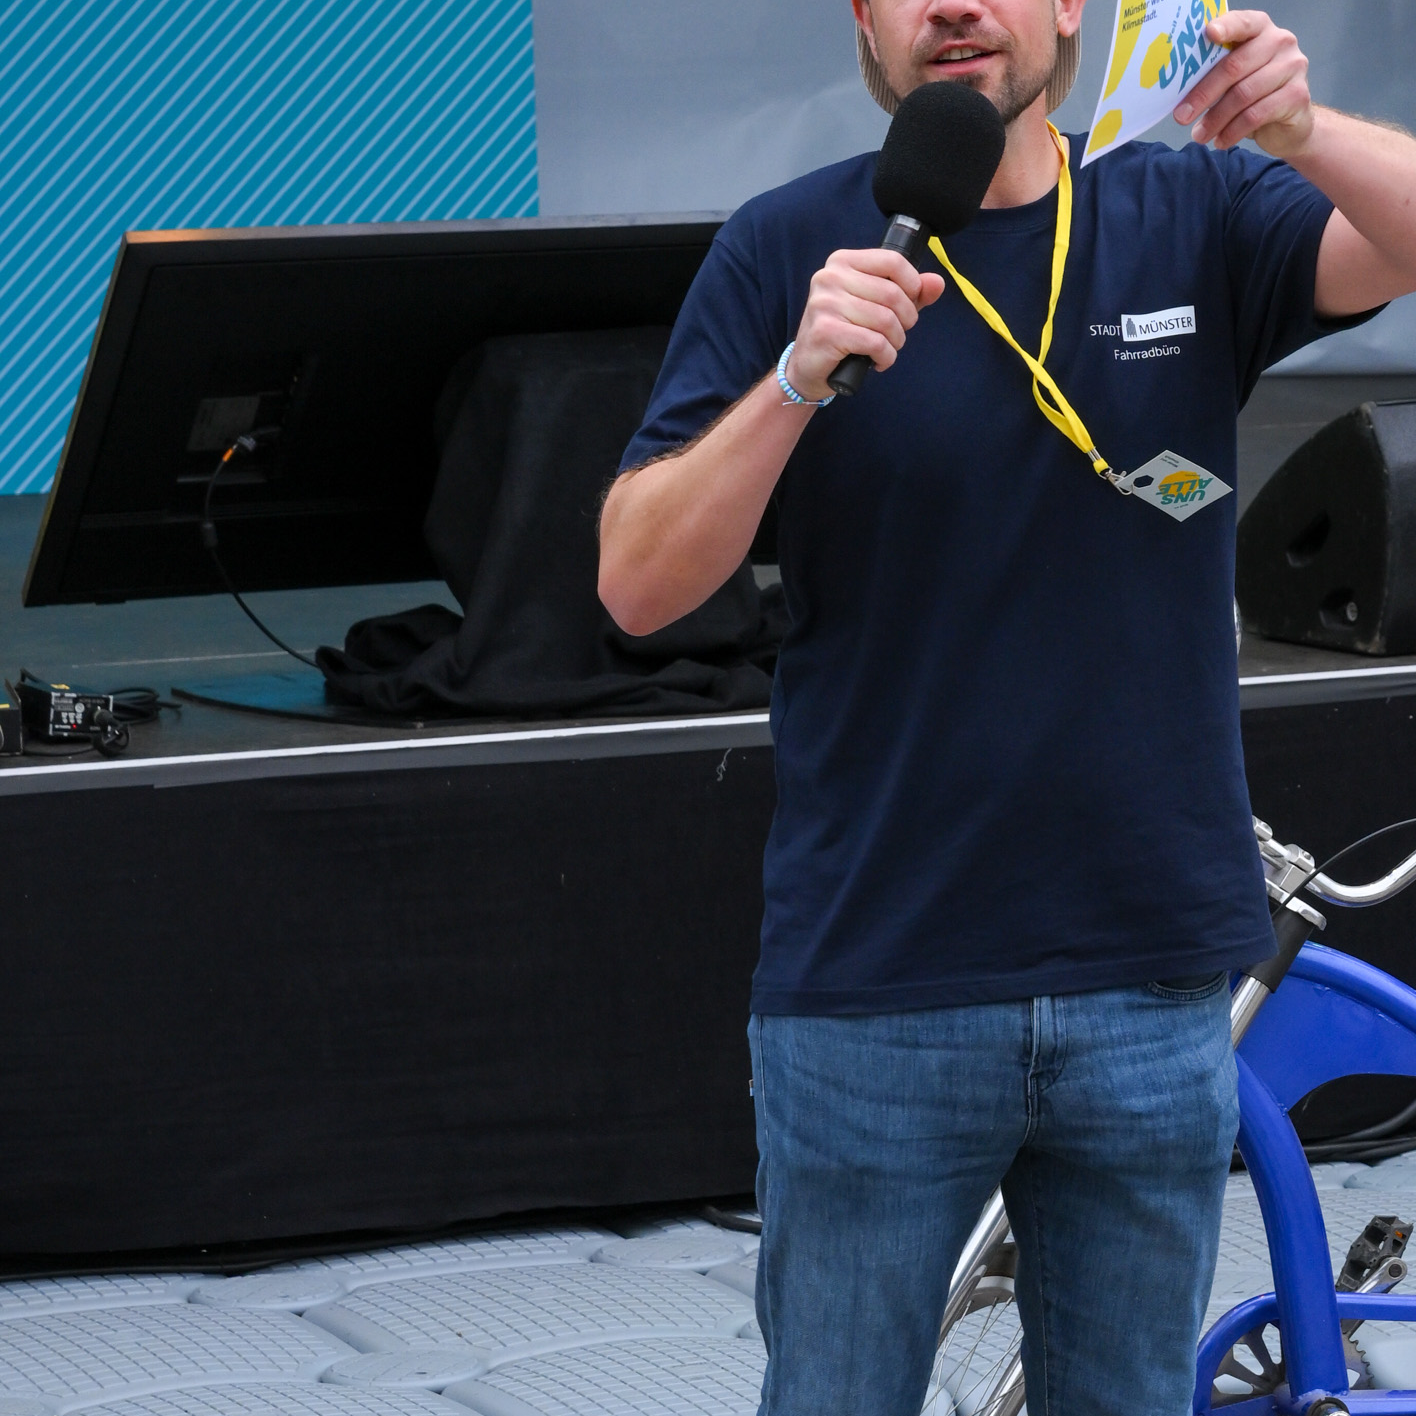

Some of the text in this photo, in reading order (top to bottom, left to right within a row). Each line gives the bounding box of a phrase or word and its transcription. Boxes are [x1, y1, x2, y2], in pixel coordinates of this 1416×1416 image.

[1089, 316, 1193, 337] STADT MÜNSTER
[1113, 345, 1181, 360] Fahrradbüro
[1155, 477, 1215, 496] ALLE
[1160, 489, 1206, 505] UNS
